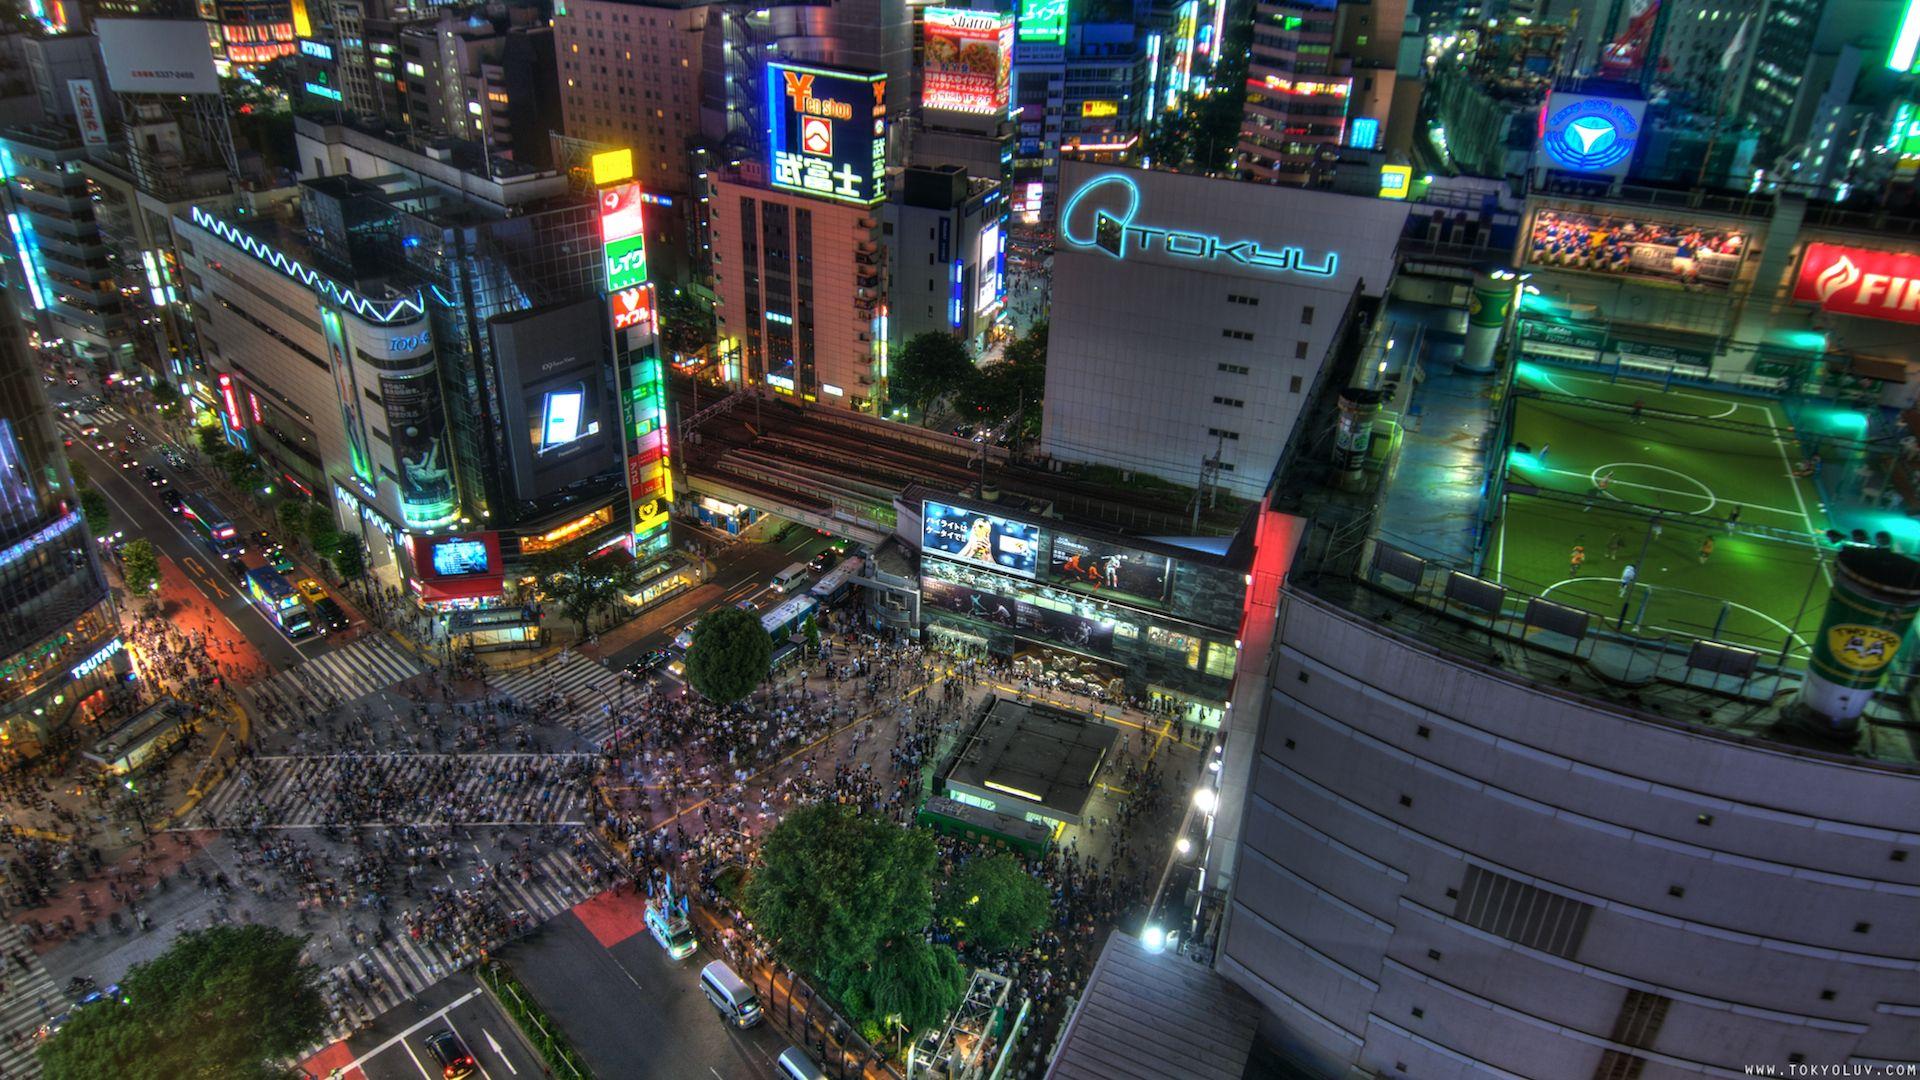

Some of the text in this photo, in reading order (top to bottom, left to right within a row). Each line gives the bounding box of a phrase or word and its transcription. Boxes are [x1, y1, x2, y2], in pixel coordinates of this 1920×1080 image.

[951, 15, 994, 30] sbarro
[775, 150, 863, 198] 武富士
[872, 137, 886, 198] 武富士
[608, 248, 645, 276] レイク
[1126, 226, 1339, 276] TOKYU
[615, 310, 650, 329] アイフル
[926, 517, 968, 533] ハイライトは
[70, 638, 123, 679] TSUTAYA
